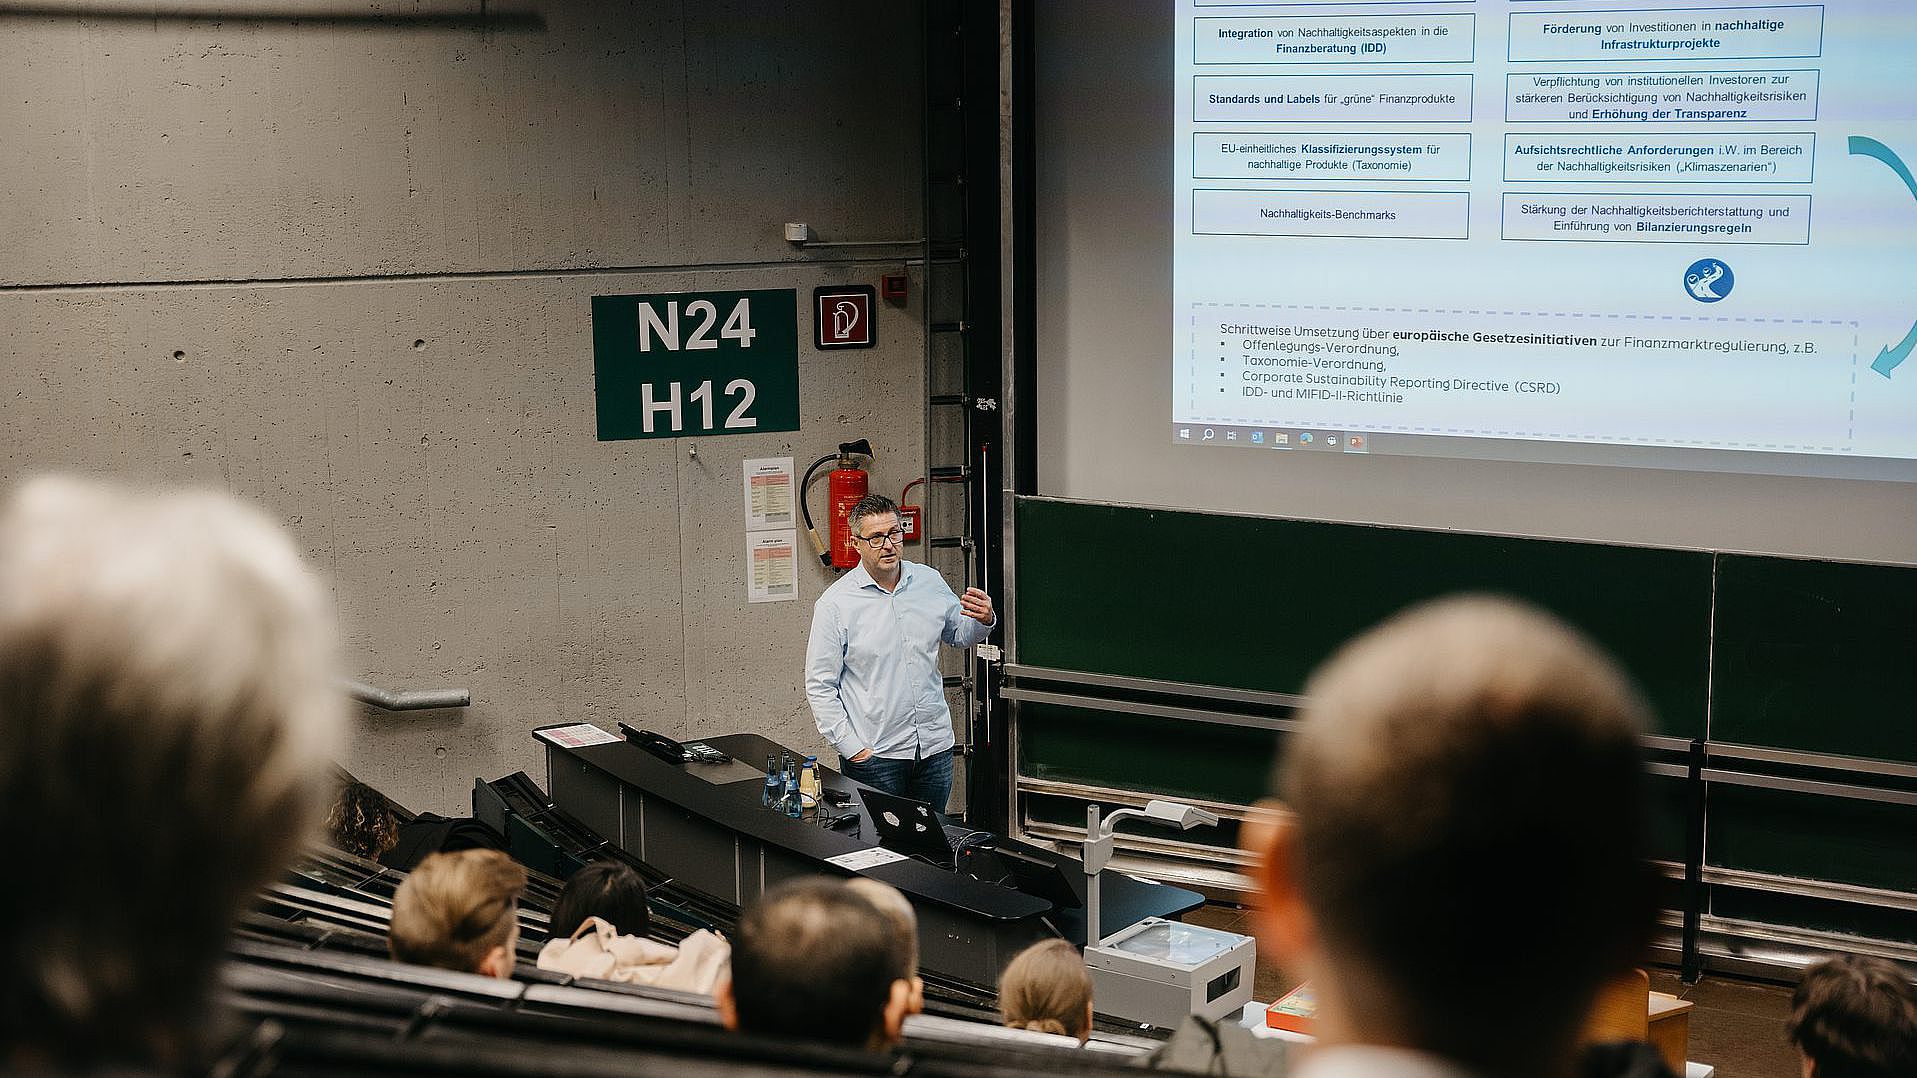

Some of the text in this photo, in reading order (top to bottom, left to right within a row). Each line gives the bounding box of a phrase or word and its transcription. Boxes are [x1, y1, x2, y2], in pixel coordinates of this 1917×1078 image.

[1218, 26, 1448, 40] Integration von Nachhaltigkeitsaspekten in die
[1543, 19, 1784, 36] Förderung von Investitionen in nachhaltige
[1276, 43, 1387, 55] Finanzberatung (IDD)
[1601, 38, 1720, 51] Infrastrukturprojekte
[1533, 74, 1789, 88] Verpflichtung von institutionellen Investoren zur
[1209, 94, 1455, 106] Standards und Labels für „grüne“ Finanzprodukte
[1516, 90, 1806, 105] stärkeren Berücksichtigung von Nachhaltigkeitsrisiken
[1569, 108, 1747, 121] und Erhöhung der Transparenz
[1221, 144, 1440, 156] EU-einheitliches Klassifizierungssystem für
[1515, 145, 1802, 158] Aufsichtsrechtliche Anforderungen i.W. im Bereich
[1248, 159, 1411, 172] nachhaltige Produkte (Taxonomie)
[1537, 161, 1776, 174] der Nachhaltigkeitsrisiken („Klimaszenarien“)
[1260, 209, 1396, 221] Nachhaltigkeits-Benchmarks
[1521, 205, 1789, 219] Stärkung der Nachhaltigkeitsberichterstattung und
[1553, 221, 1752, 235] Einführung von Bilanzierungsregeln
[638, 298, 756, 352] N24
[1220, 323, 1817, 355] Schrittweise Umsetzung über europäische Gesetzesinitiativen zur Finanzmarktregulierung, z.B.
[1243, 339, 1399, 356] Offenlegungs-Verordnung,
[1243, 355, 1386, 372] Taxonomie-Verordnung,
[1242, 371, 1561, 394] Corporate Sustainability Reporting Directive (CSRD)
[1242, 386, 1403, 403] IDD- und MIFID-II-Richtlinie
[641, 379, 757, 433] H12
